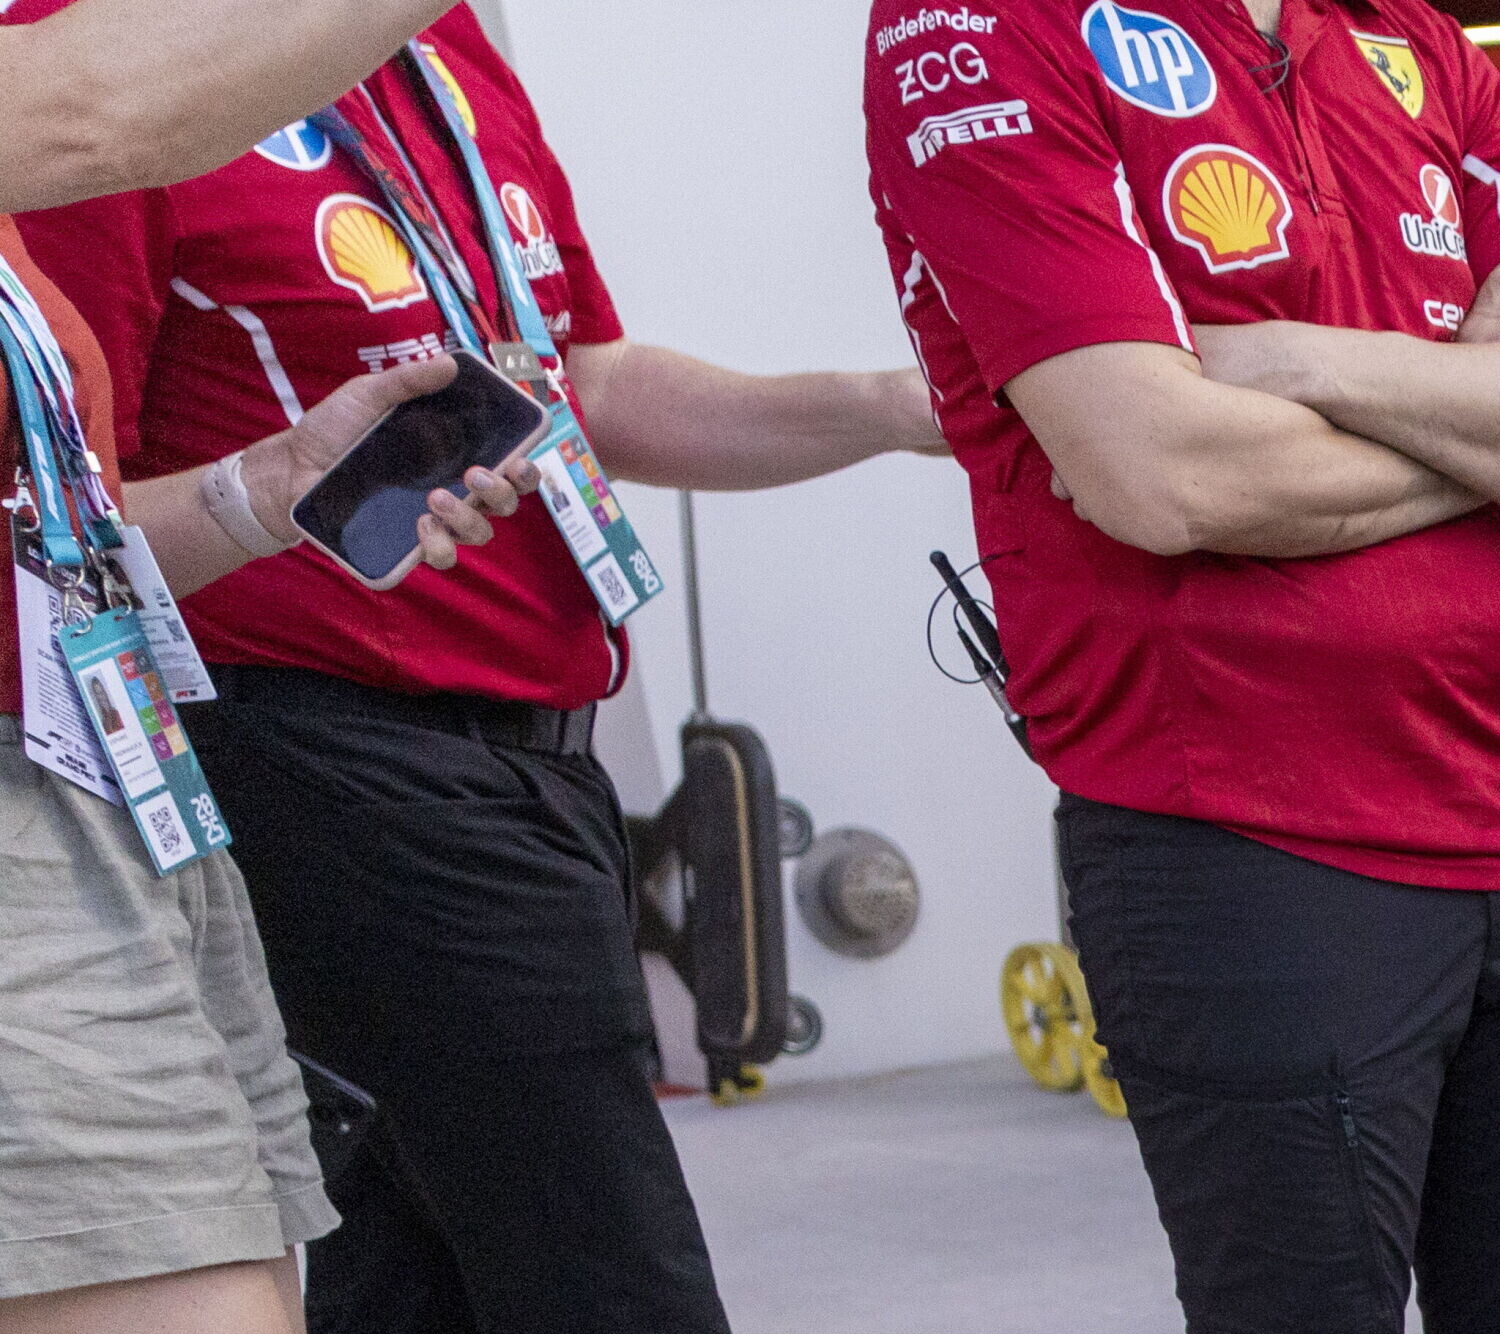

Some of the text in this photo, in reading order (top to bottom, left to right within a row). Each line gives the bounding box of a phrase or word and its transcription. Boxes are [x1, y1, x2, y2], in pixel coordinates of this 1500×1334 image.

[876, 7, 997, 56] Bitdefender
[1100, 0, 1194, 116] hp
[895, 42, 989, 106] ZCG
[906, 99, 1034, 168] PIRELLI
